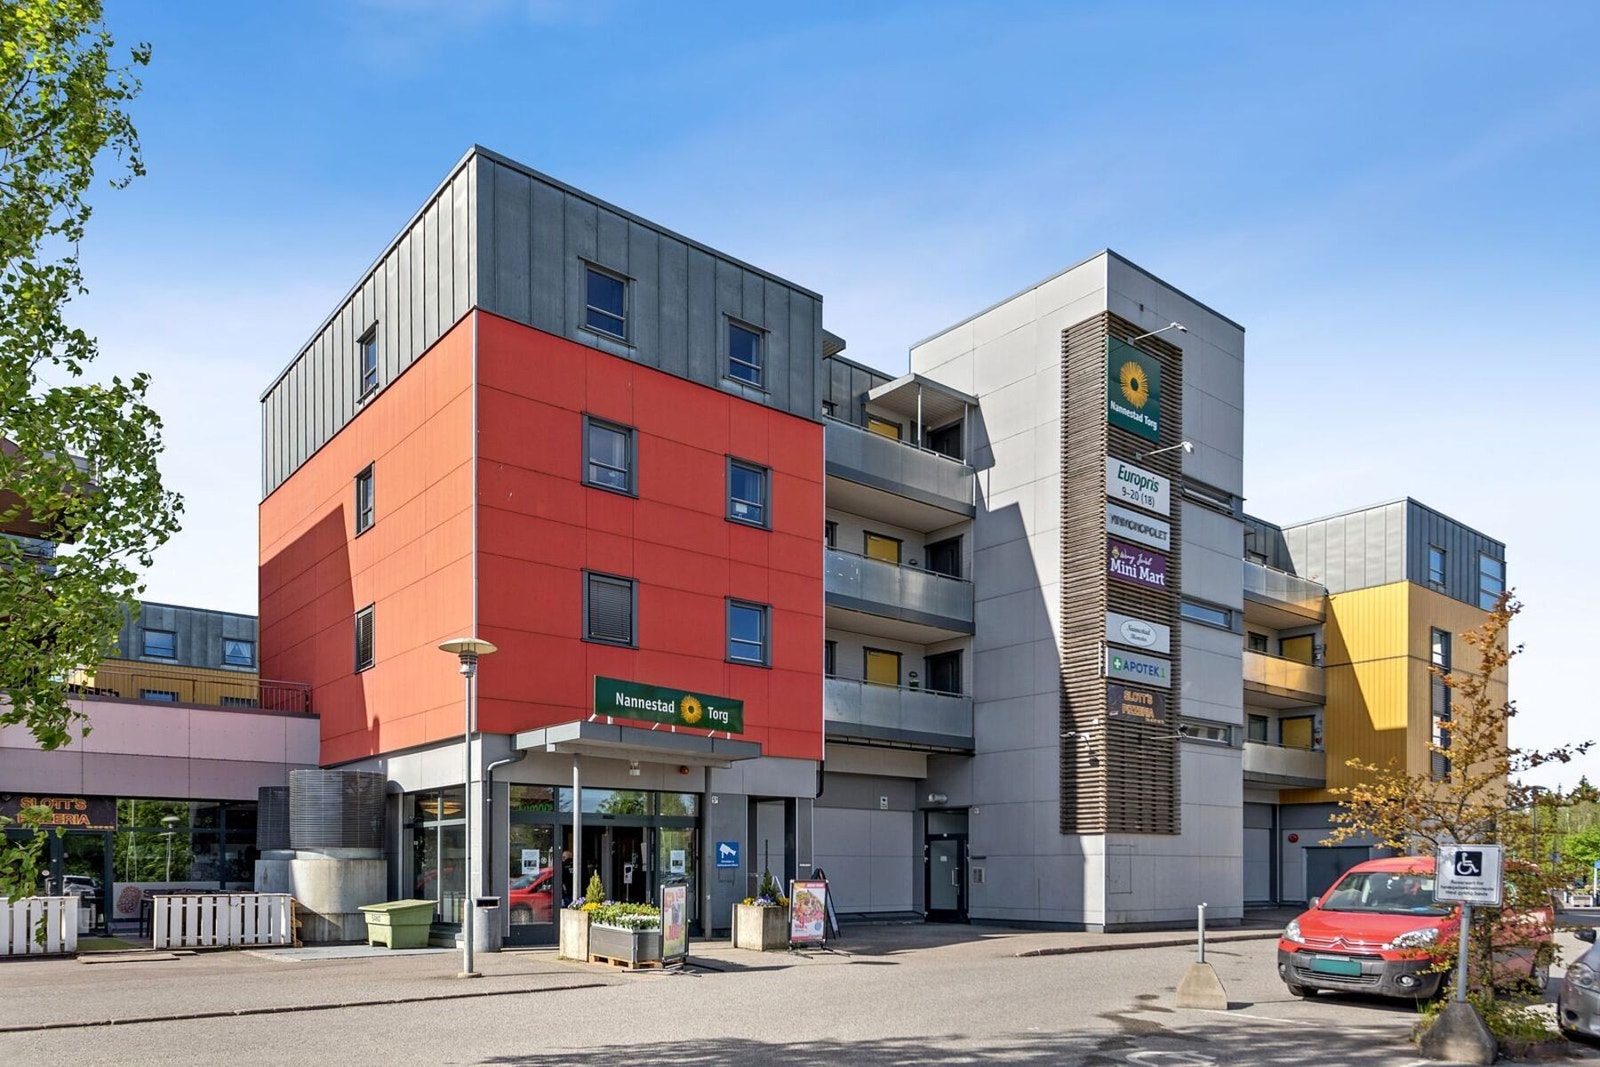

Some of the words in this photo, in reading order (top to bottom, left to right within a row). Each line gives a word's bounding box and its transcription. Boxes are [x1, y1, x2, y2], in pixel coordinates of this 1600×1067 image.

[1110, 400, 1143, 423] Nannestad
[1144, 415, 1158, 431] Torg
[1118, 465, 1160, 493] Europris
[1141, 493, 1155, 508] (18)
[1110, 558, 1137, 578] Mini
[1139, 566, 1165, 586] Mart
[1123, 660, 1160, 677] APOTEK
[615, 692, 675, 713] Nannestad
[707, 706, 729, 724] Torg
